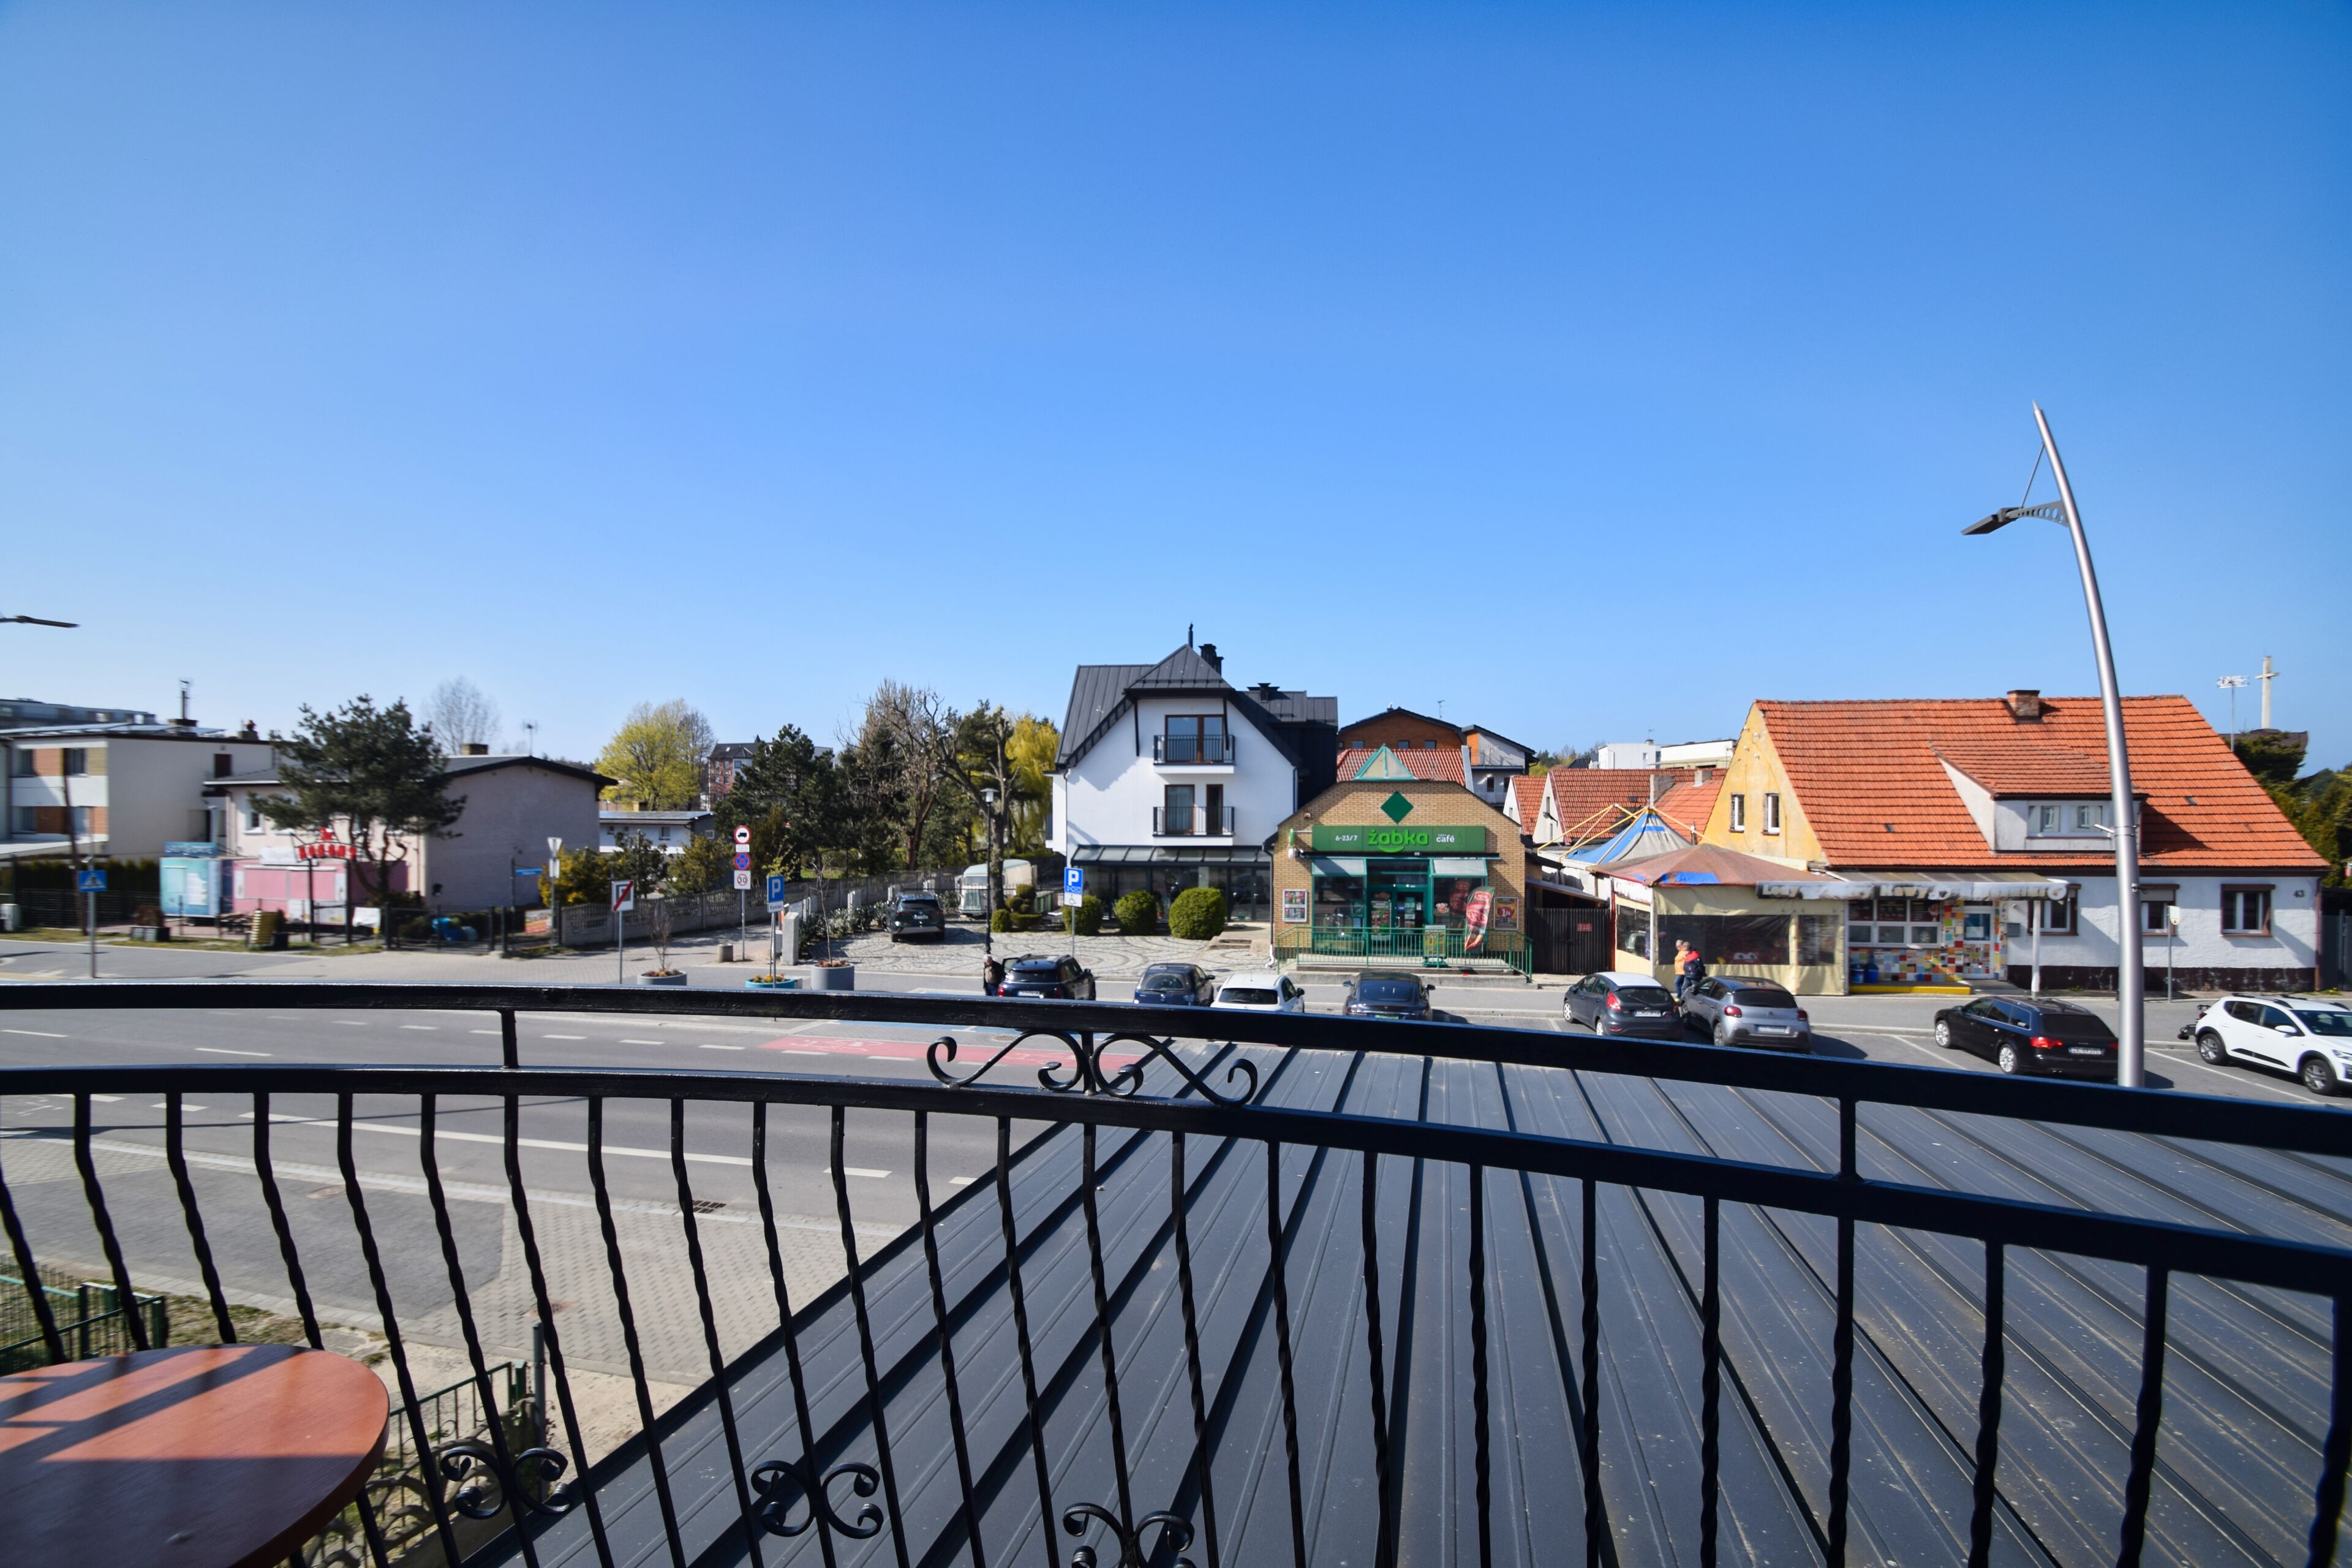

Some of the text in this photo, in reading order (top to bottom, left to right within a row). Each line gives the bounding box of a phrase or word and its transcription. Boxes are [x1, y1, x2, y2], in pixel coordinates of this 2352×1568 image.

[1368, 829, 1430, 845] żabka
[1436, 834, 1455, 843] café
[1068, 870, 1079, 886] P
[772, 878, 781, 899] P
